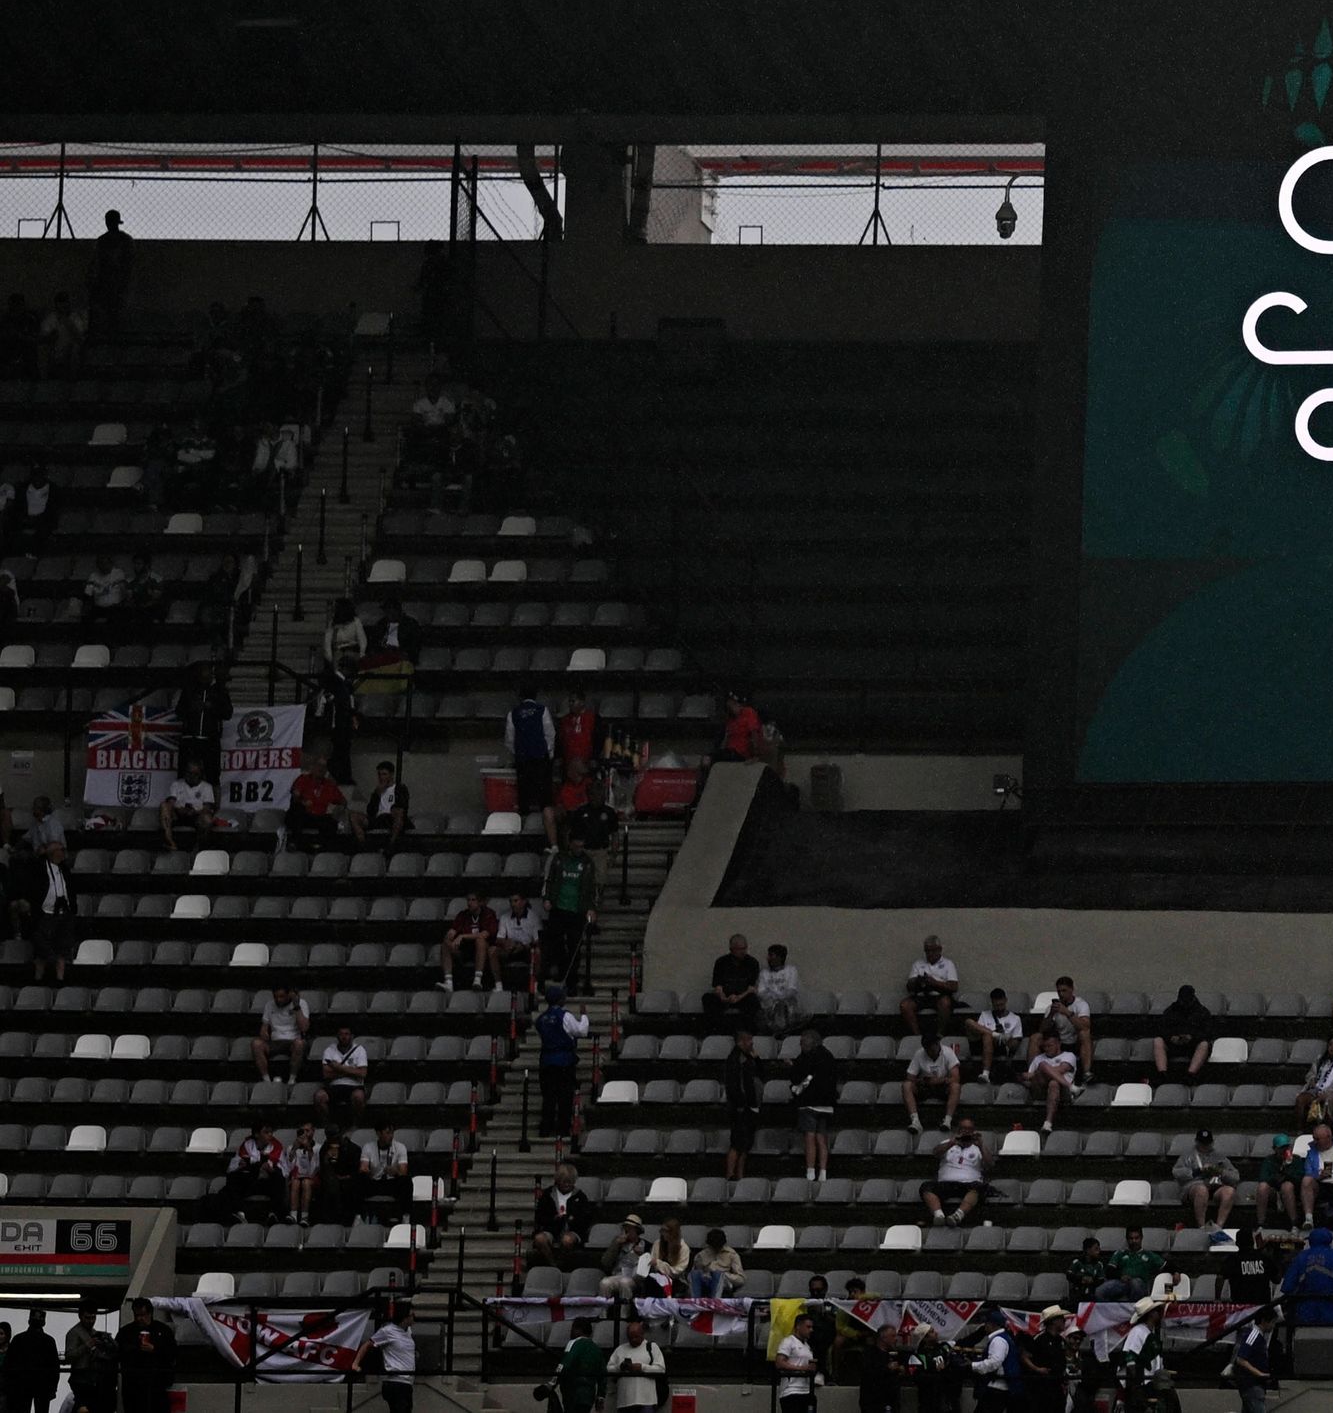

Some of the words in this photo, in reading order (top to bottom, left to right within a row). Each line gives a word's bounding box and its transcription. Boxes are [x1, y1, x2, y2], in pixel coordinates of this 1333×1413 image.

[96, 749, 178, 770] BLACKB
[221, 747, 293, 770] ROVERS
[229, 781, 274, 803] BB2
[0, 1221, 43, 1241] DA
[70, 1222, 118, 1251] 66
[1241, 1259, 1265, 1275] DONAS
[914, 1300, 947, 1327] OUTHEND
[283, 1339, 338, 1365] AFC
